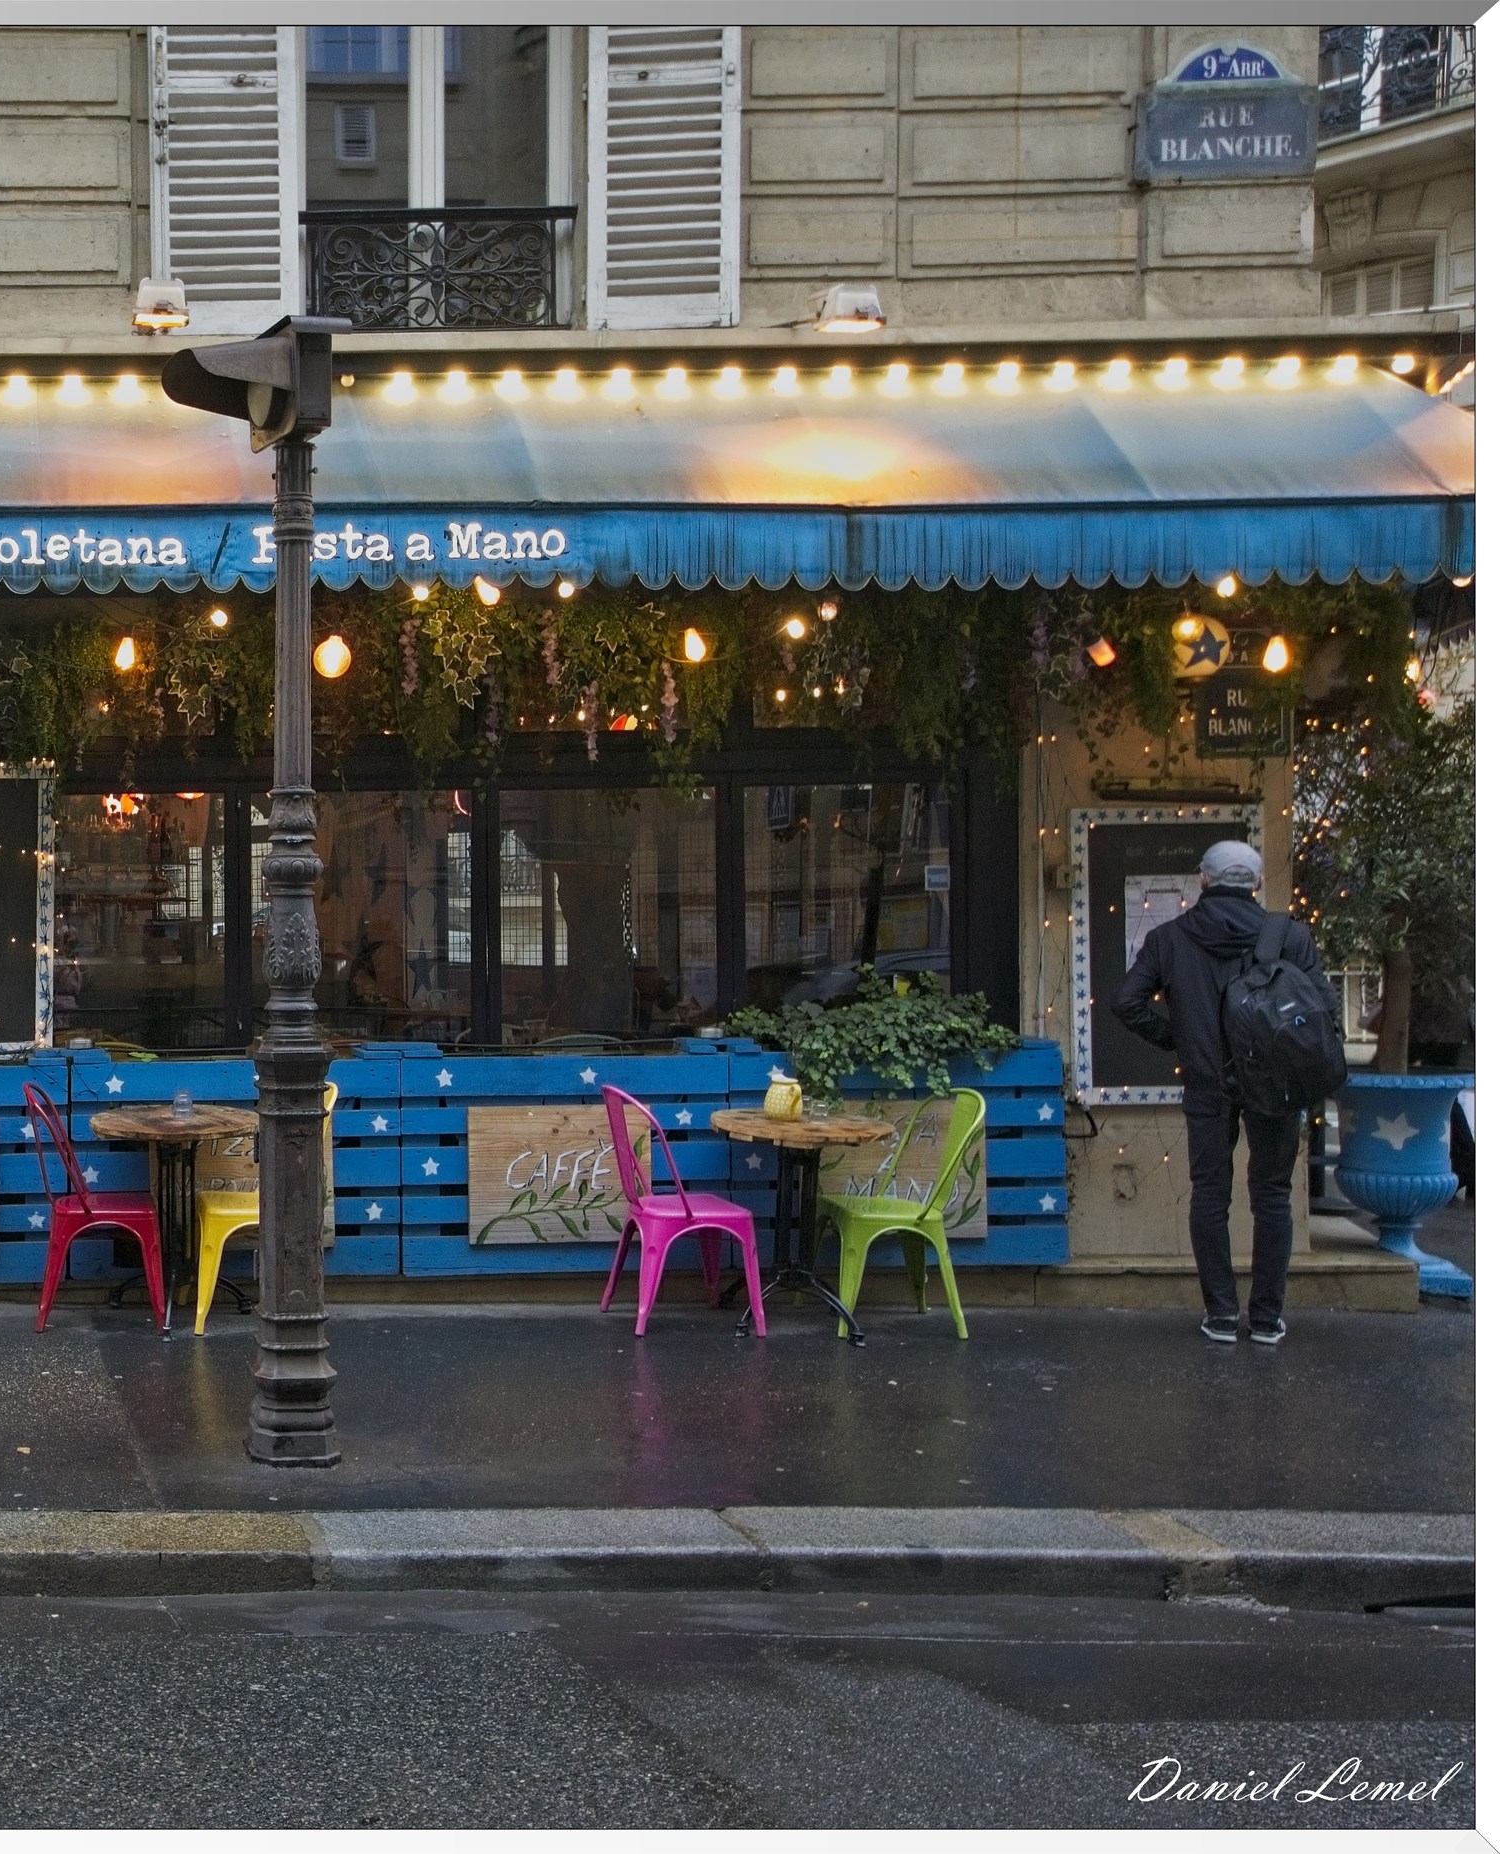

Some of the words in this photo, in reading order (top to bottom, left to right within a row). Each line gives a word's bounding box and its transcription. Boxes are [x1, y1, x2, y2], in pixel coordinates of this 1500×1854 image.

[1199, 103, 1254, 128] RUE
[251, 522, 394, 564] Psta
[406, 533, 435, 562] a
[448, 522, 567, 560] Mano
